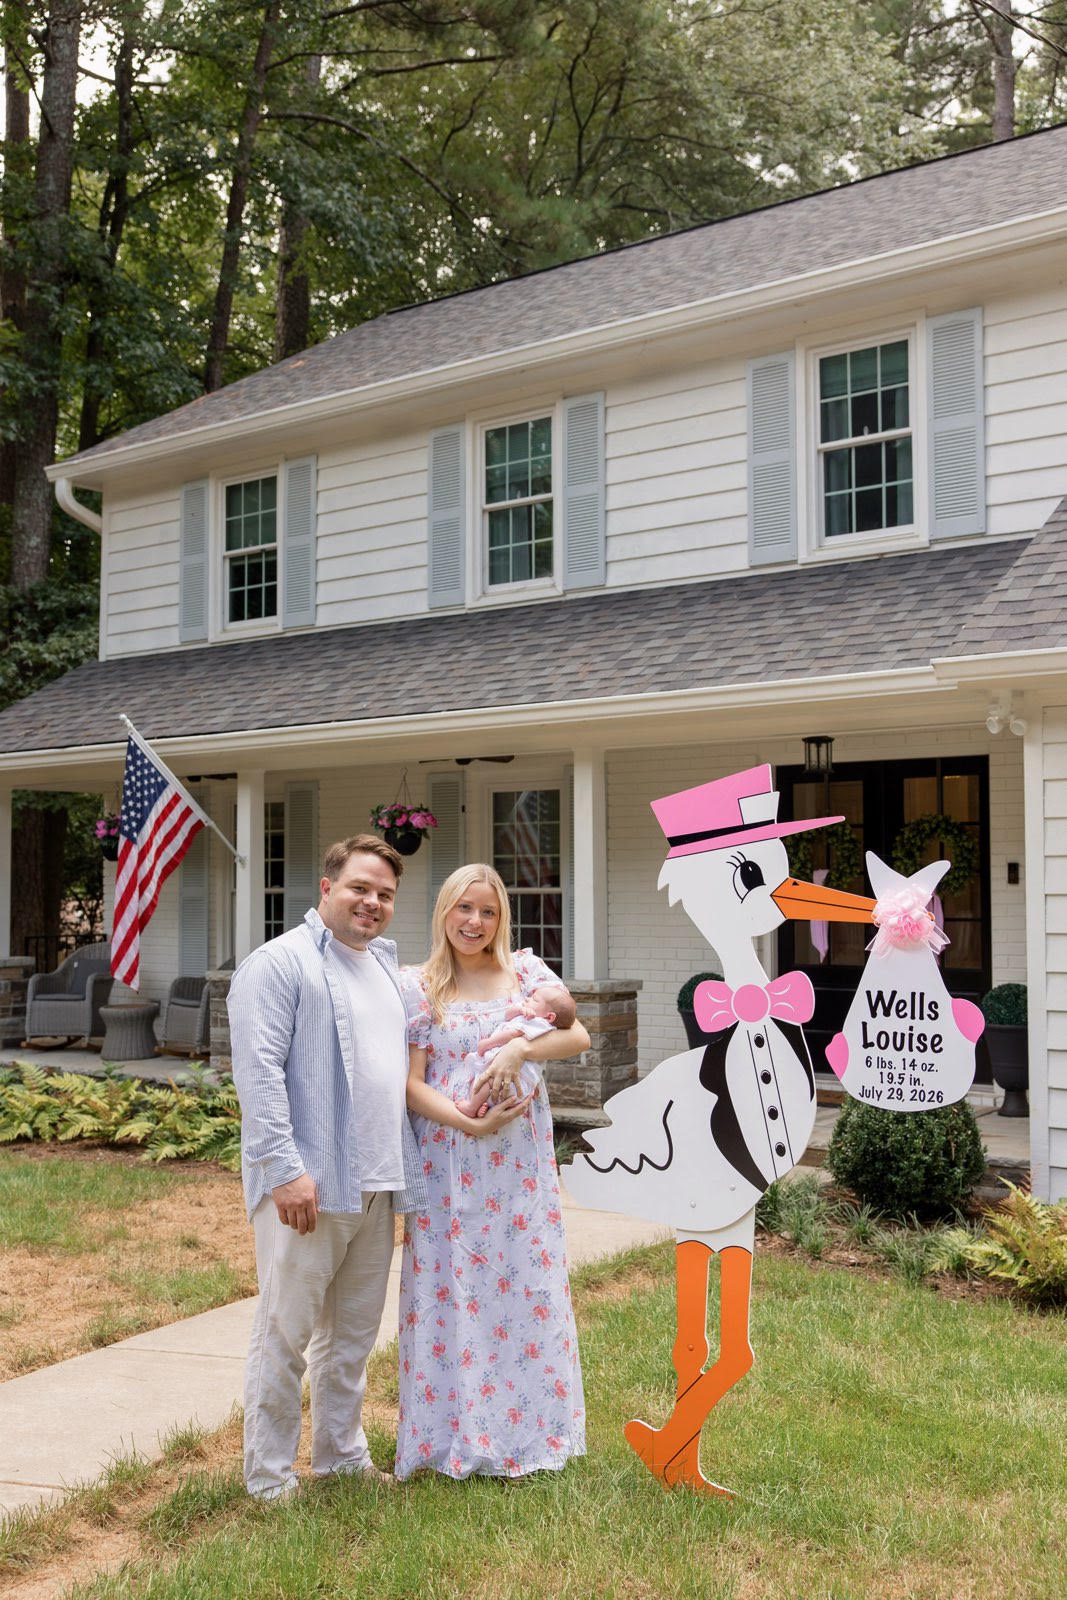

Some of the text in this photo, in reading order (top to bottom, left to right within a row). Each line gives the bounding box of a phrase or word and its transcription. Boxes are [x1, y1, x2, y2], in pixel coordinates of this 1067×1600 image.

[865, 990, 939, 1021] Wells
[861, 1021, 943, 1053] Louise
[865, 1055, 938, 1072] 6 lbs. 14 oz.
[880, 1071, 924, 1087] 19.5 in.
[859, 1085, 944, 1103] July 29, 2026
